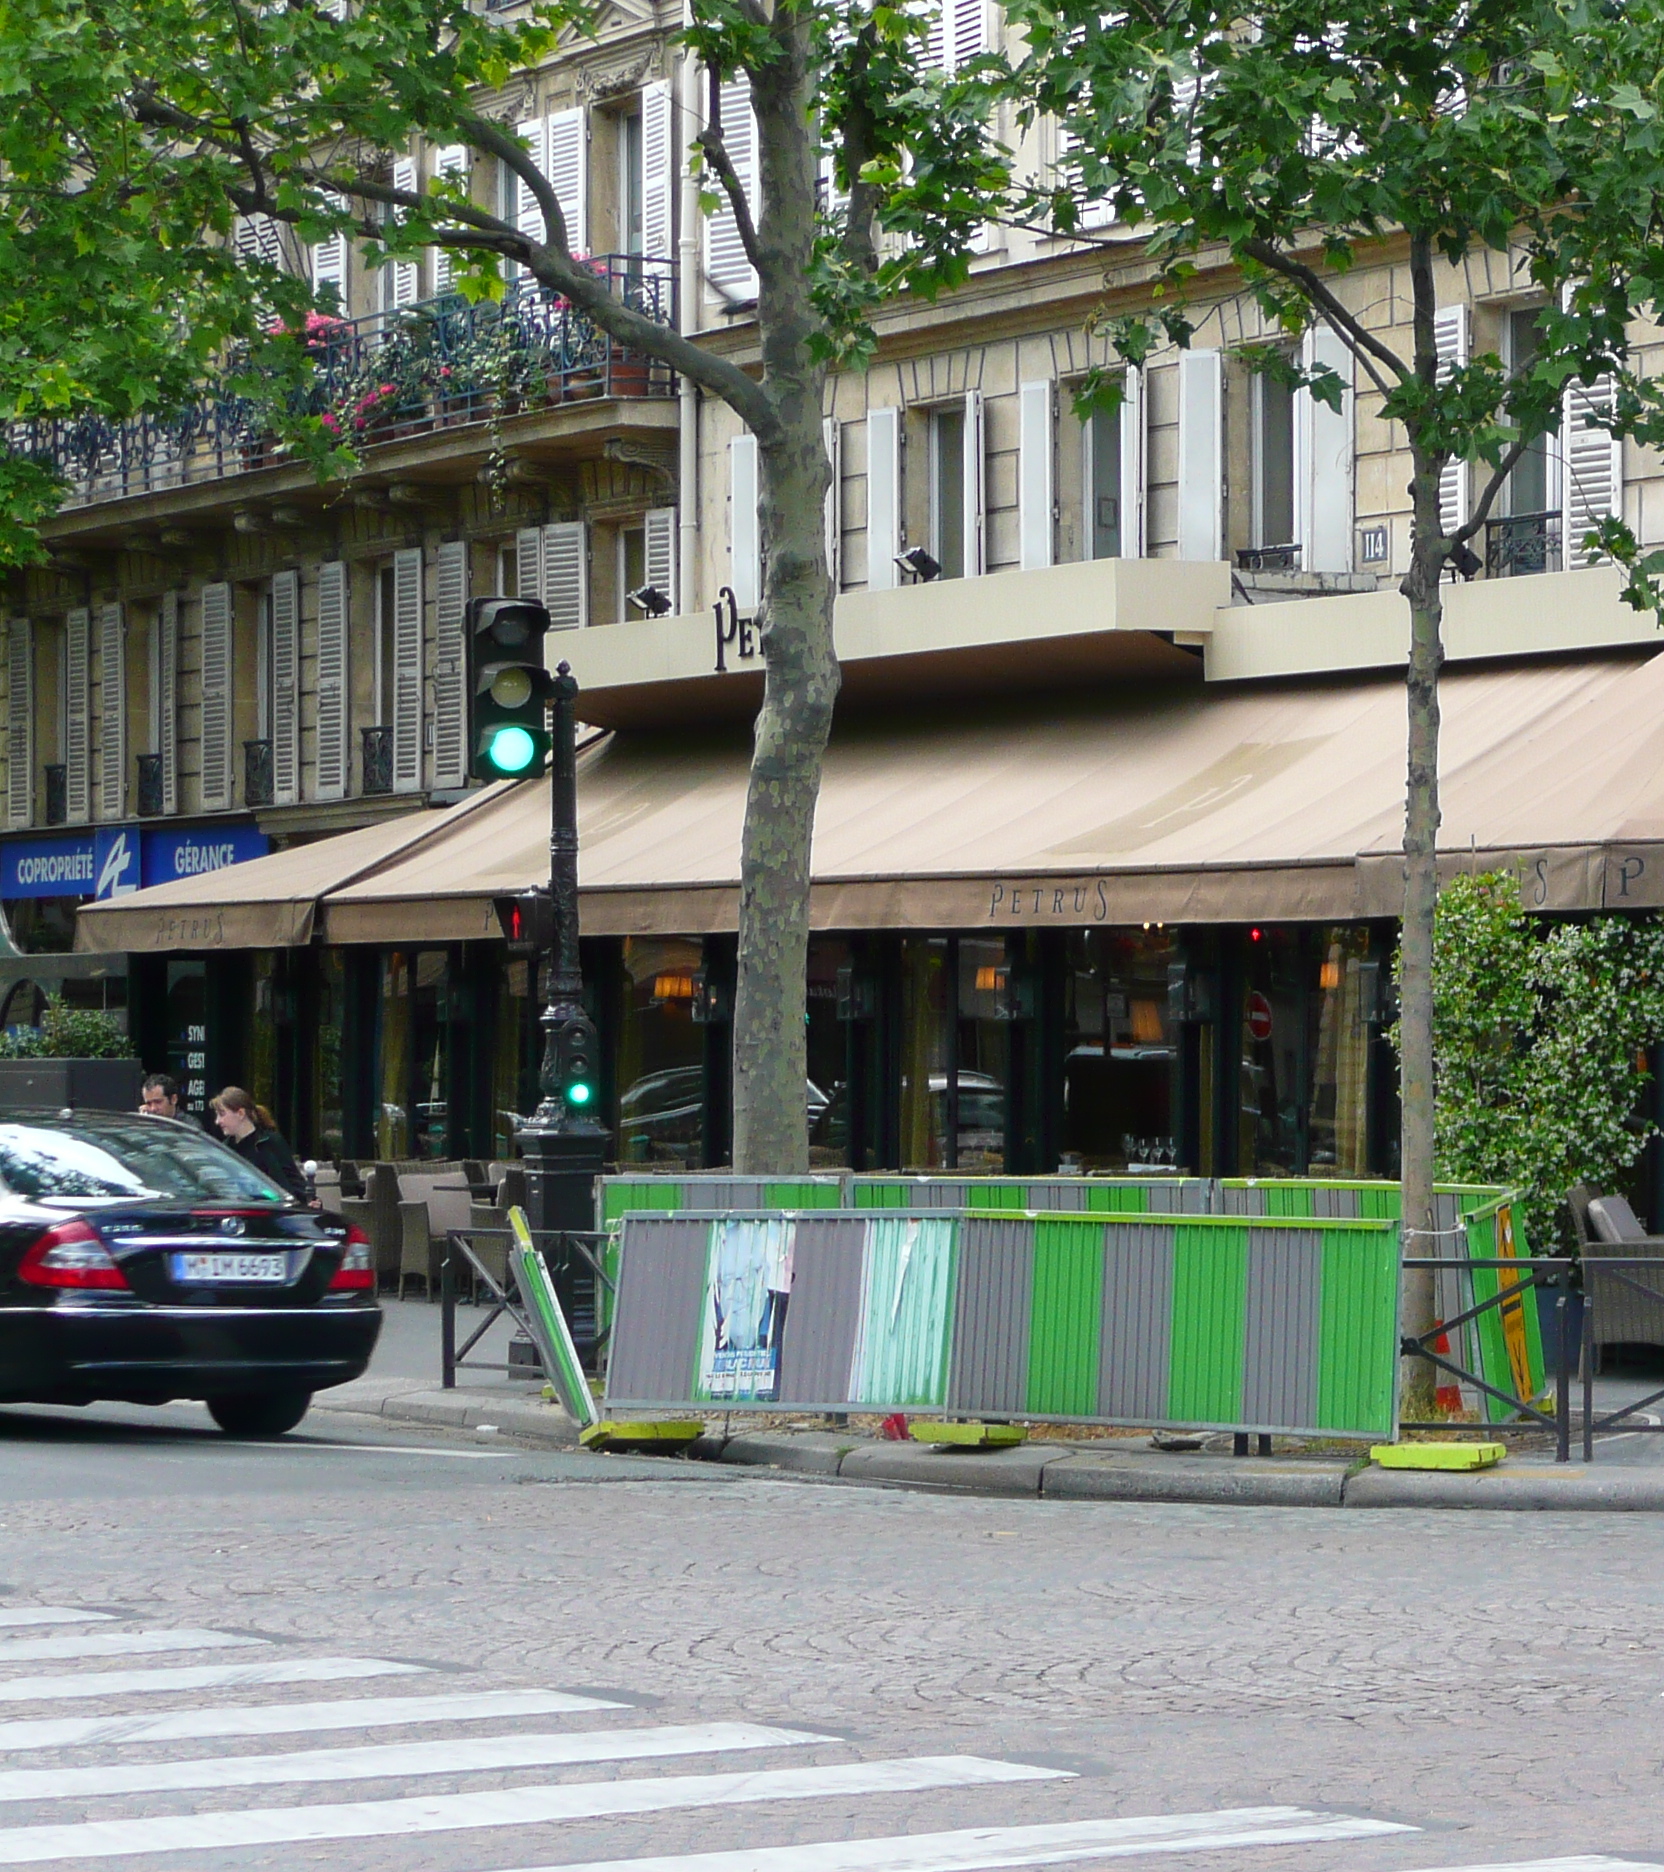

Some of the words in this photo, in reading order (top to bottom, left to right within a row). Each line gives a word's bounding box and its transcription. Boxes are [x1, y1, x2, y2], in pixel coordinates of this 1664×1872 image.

[1365, 532, 1384, 559] 114
[17, 846, 94, 885] COPROPRIÉTÉ
[174, 839, 235, 875] GÉRANCE
[989, 879, 1107, 921] PETRUS
[155, 911, 224, 945] PETRUS
